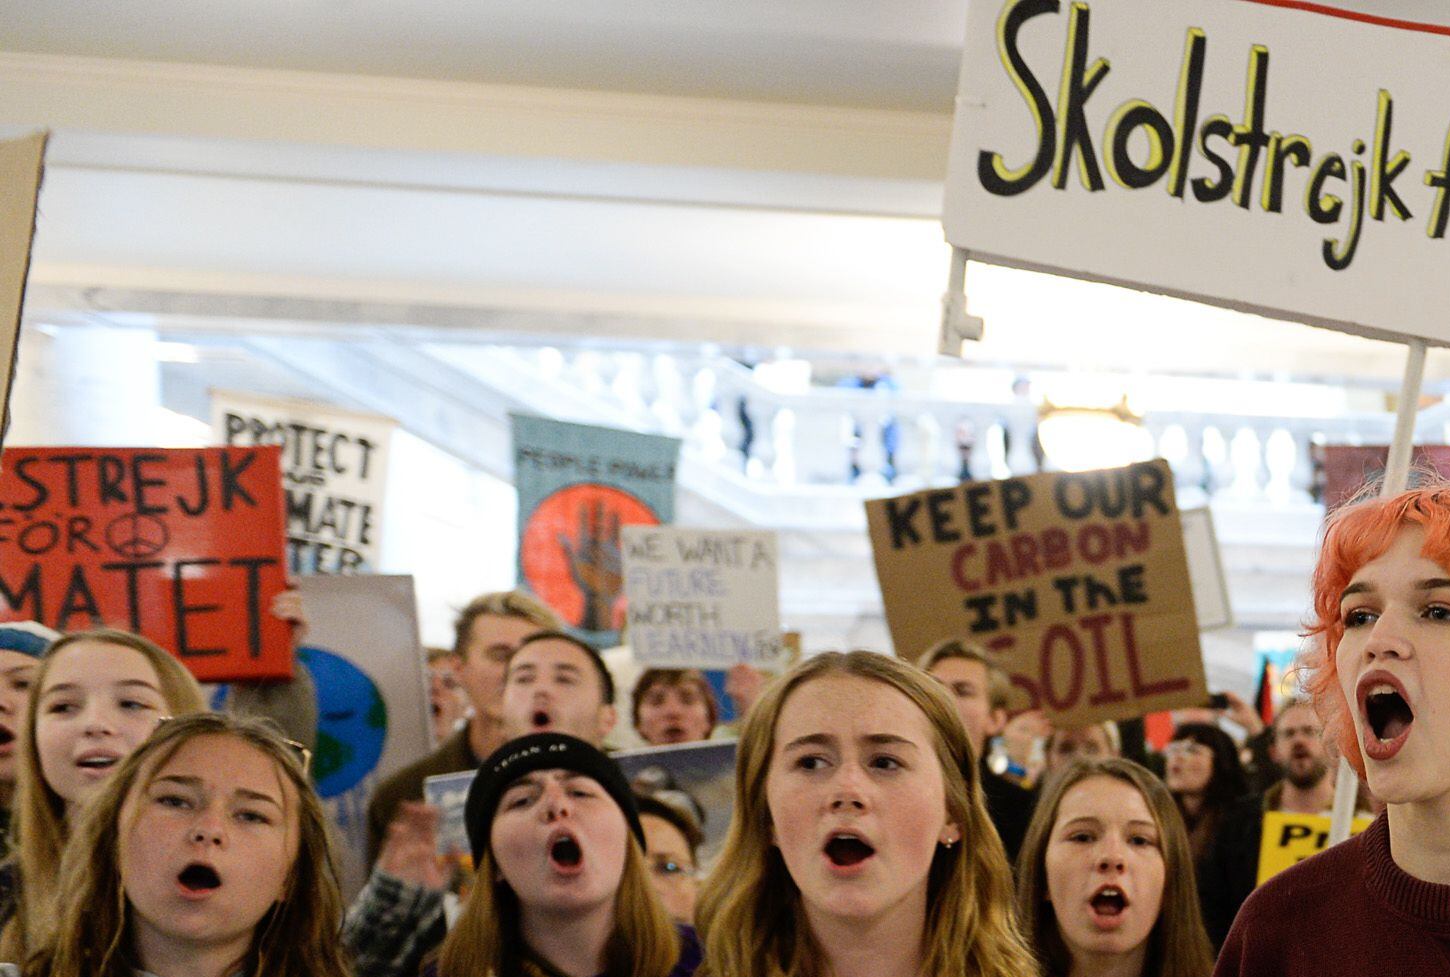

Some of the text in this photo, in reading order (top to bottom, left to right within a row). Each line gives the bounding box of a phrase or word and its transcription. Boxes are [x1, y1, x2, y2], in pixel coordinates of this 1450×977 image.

[976, 0, 1414, 272] Skolstrejk
[225, 413, 375, 479] PROTECT
[12, 450, 258, 517] STREJK
[884, 462, 1171, 549] KEEP OUR
[951, 522, 1151, 592] CARBON
[964, 588, 1038, 632] IN
